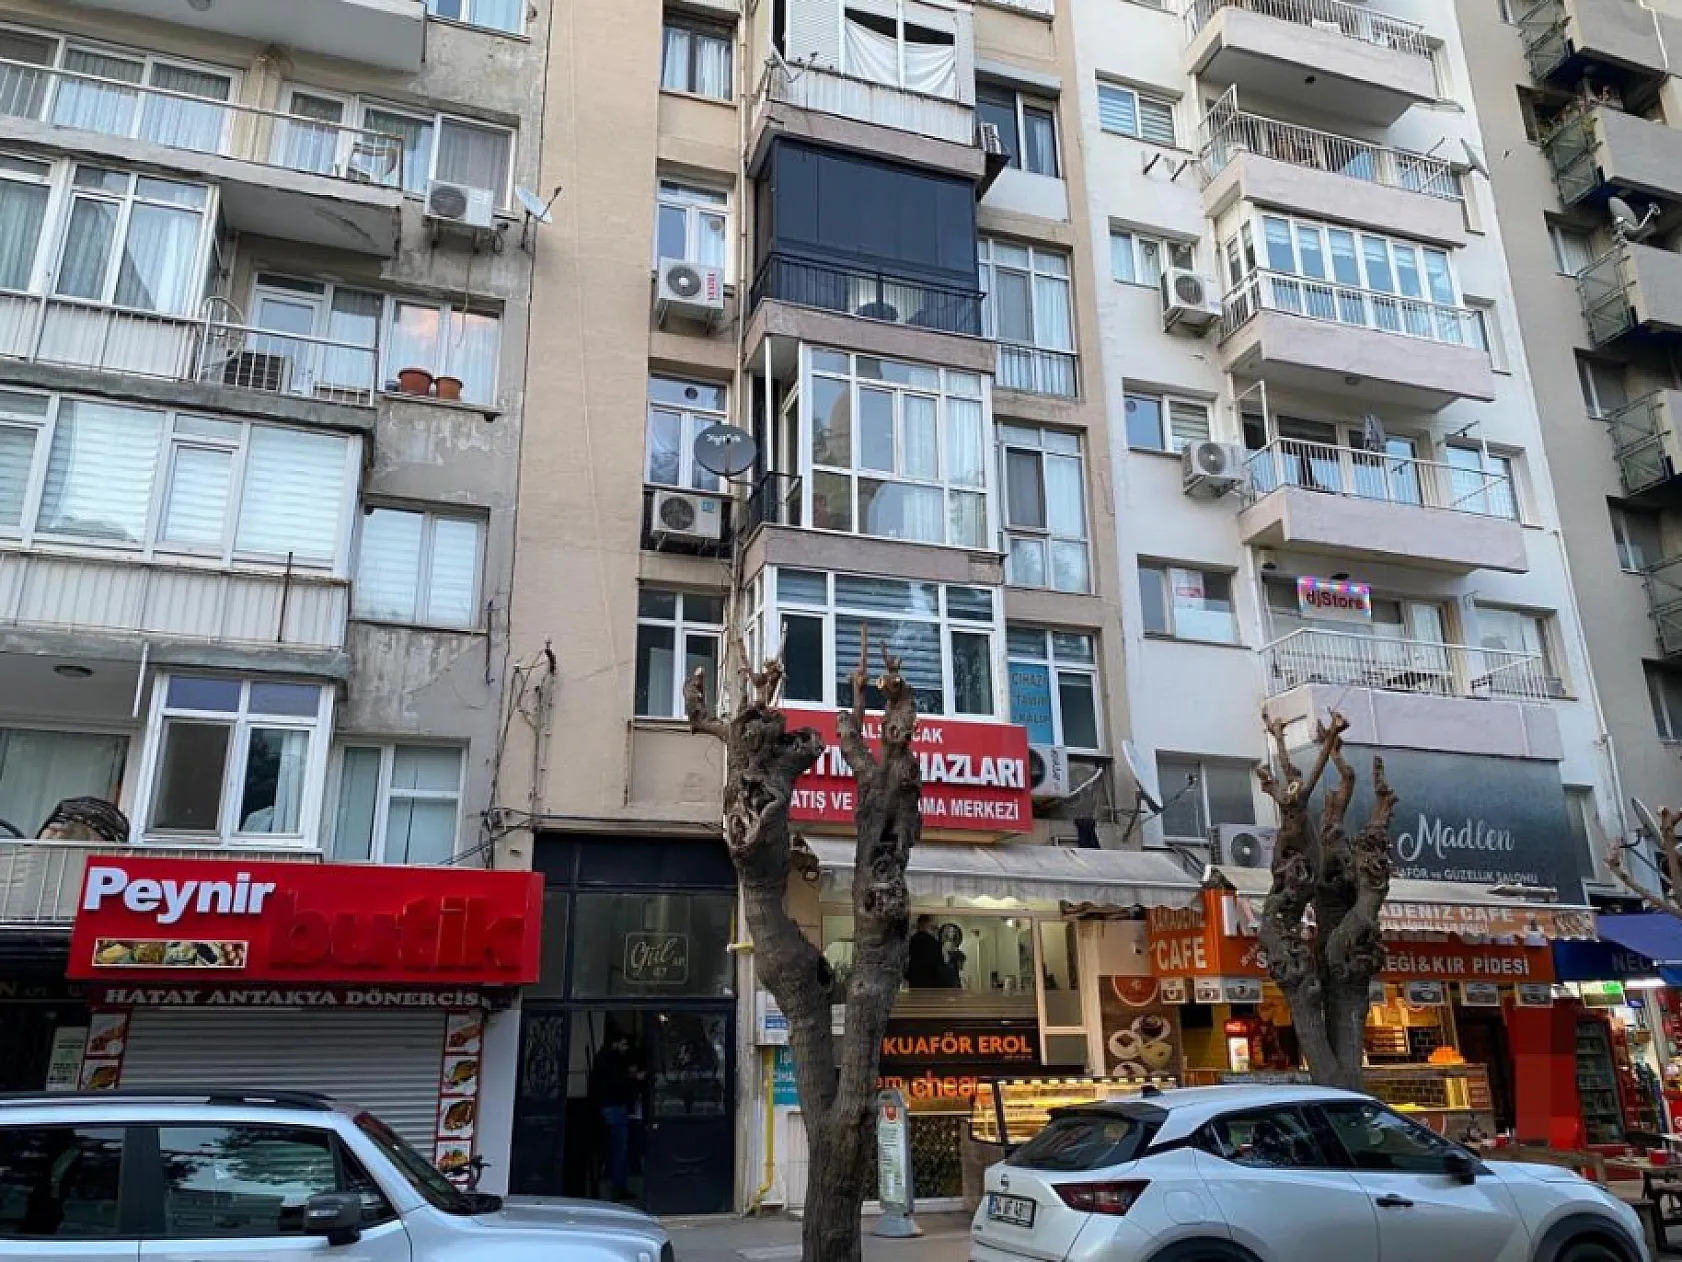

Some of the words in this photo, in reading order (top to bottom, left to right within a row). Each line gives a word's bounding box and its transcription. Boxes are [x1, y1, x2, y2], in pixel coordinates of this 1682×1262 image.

[860, 722, 943, 744] ALSCAK
[790, 789, 826, 814] ATIŞ
[831, 791, 853, 811] VE
[950, 798, 1019, 820] MERKEZİ
[1397, 812, 1515, 862] Madlen
[84, 866, 275, 924] Peynir
[269, 888, 525, 970] butik
[1157, 937, 1208, 971] CAFE
[1473, 954, 1530, 976] PİDESİ
[104, 988, 200, 1004] HATAY
[207, 989, 338, 1005] ANTAKYA
[345, 988, 483, 1007] DÖNERCİS
[882, 1031, 973, 1055] KUAFÖR
[978, 1034, 1033, 1054] EROL
